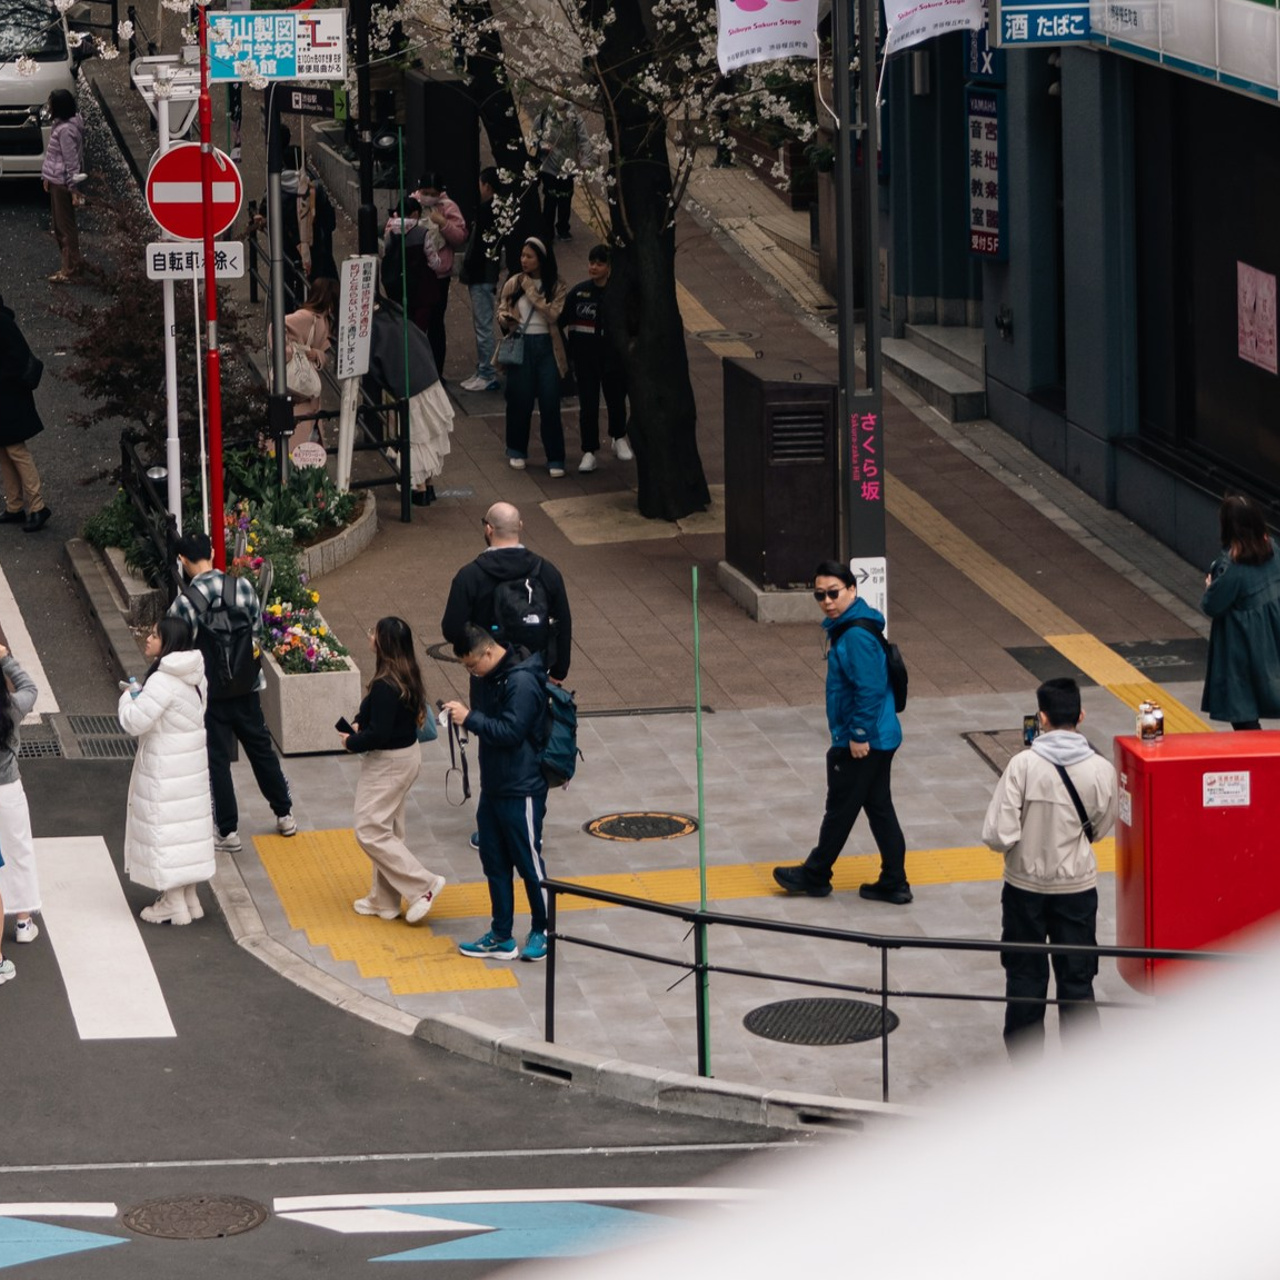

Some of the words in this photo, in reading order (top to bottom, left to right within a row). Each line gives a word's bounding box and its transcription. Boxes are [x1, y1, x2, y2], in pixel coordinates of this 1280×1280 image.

[753, 20, 778, 30] Sakura
[1005, 14, 1029, 40] 酒
[1036, 15, 1084, 37] たばこ
[970, 98, 997, 113] YAMAHA
[970, 120, 984, 227] 音楽教室
[984, 121, 998, 229] 宮地楽器
[153, 250, 238, 272] 自転車除く
[860, 412, 880, 501] さくら坂
